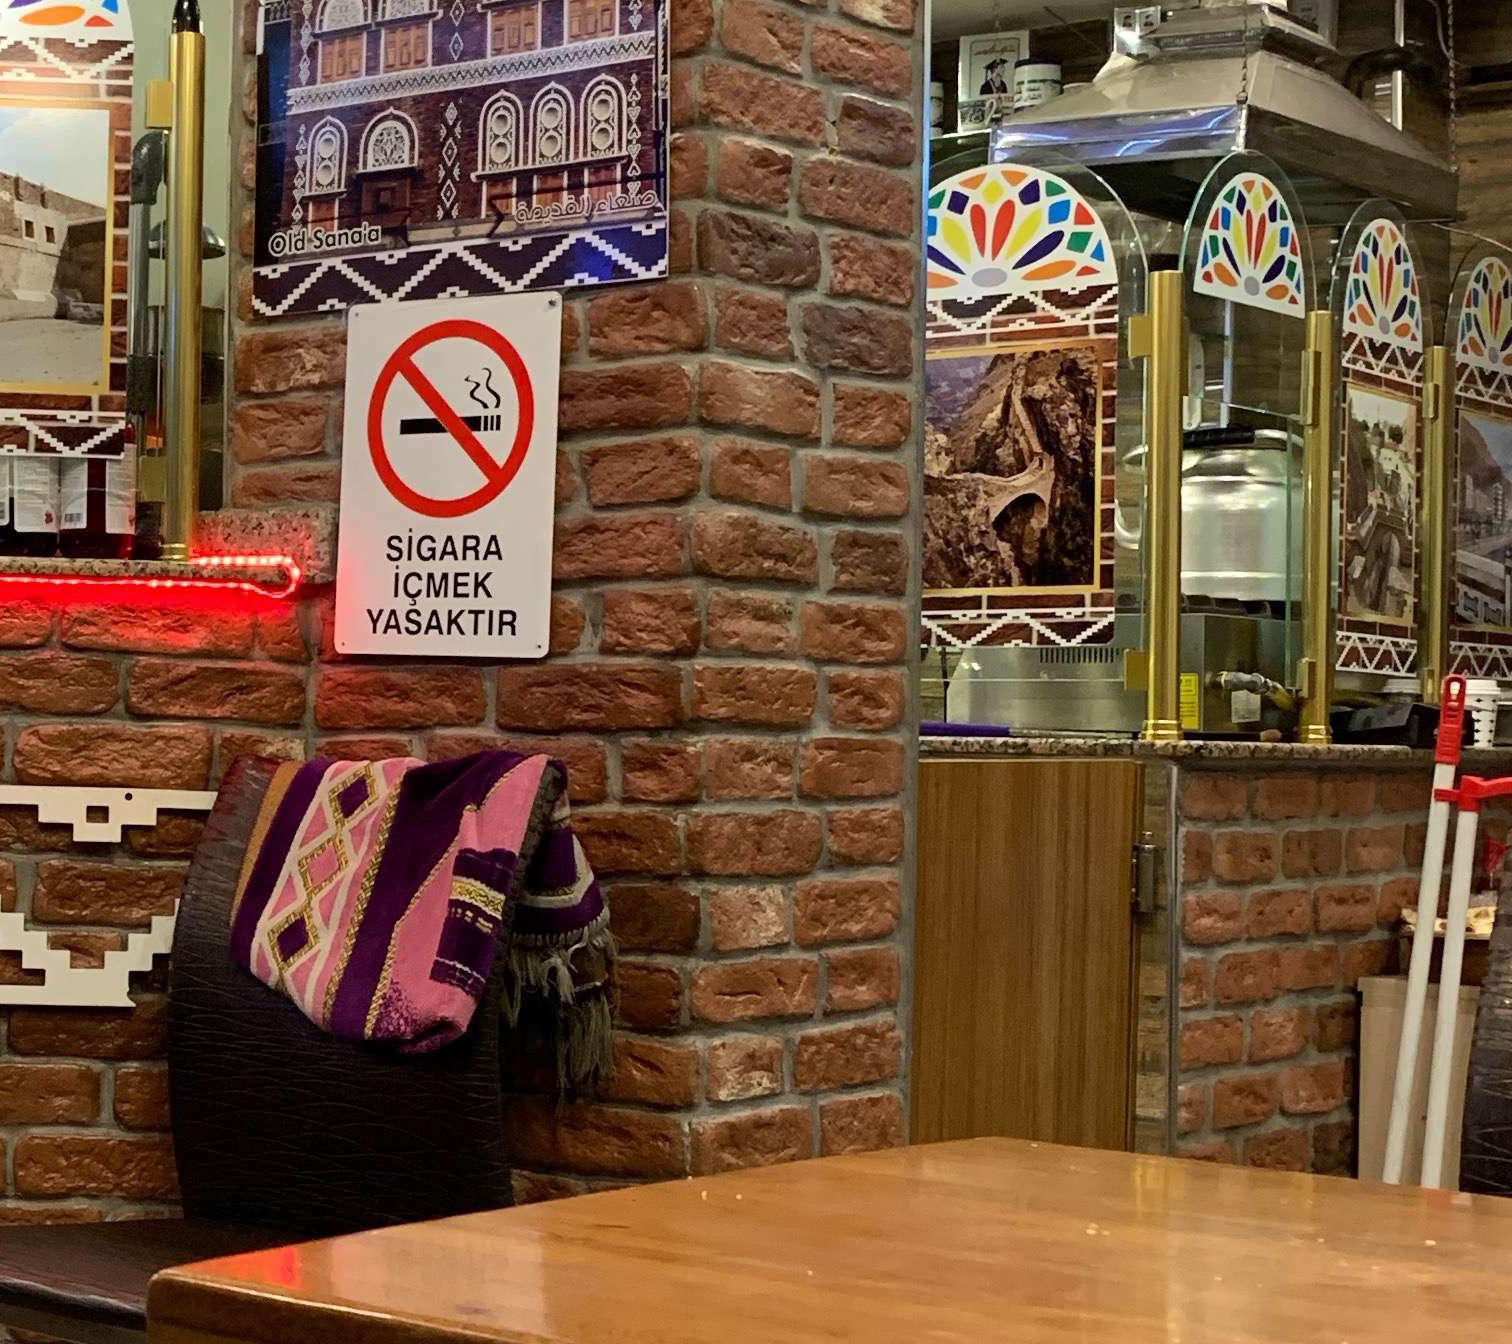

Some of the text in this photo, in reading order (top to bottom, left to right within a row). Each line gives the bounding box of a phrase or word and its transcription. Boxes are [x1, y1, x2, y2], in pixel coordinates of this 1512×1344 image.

[515, 194, 591, 224] القديمة
[269, 222, 381, 257] Old Sana'a
[386, 528, 503, 562] SİGARA
[393, 565, 493, 606] İÇMEK
[366, 609, 517, 636] YASAKTIR
